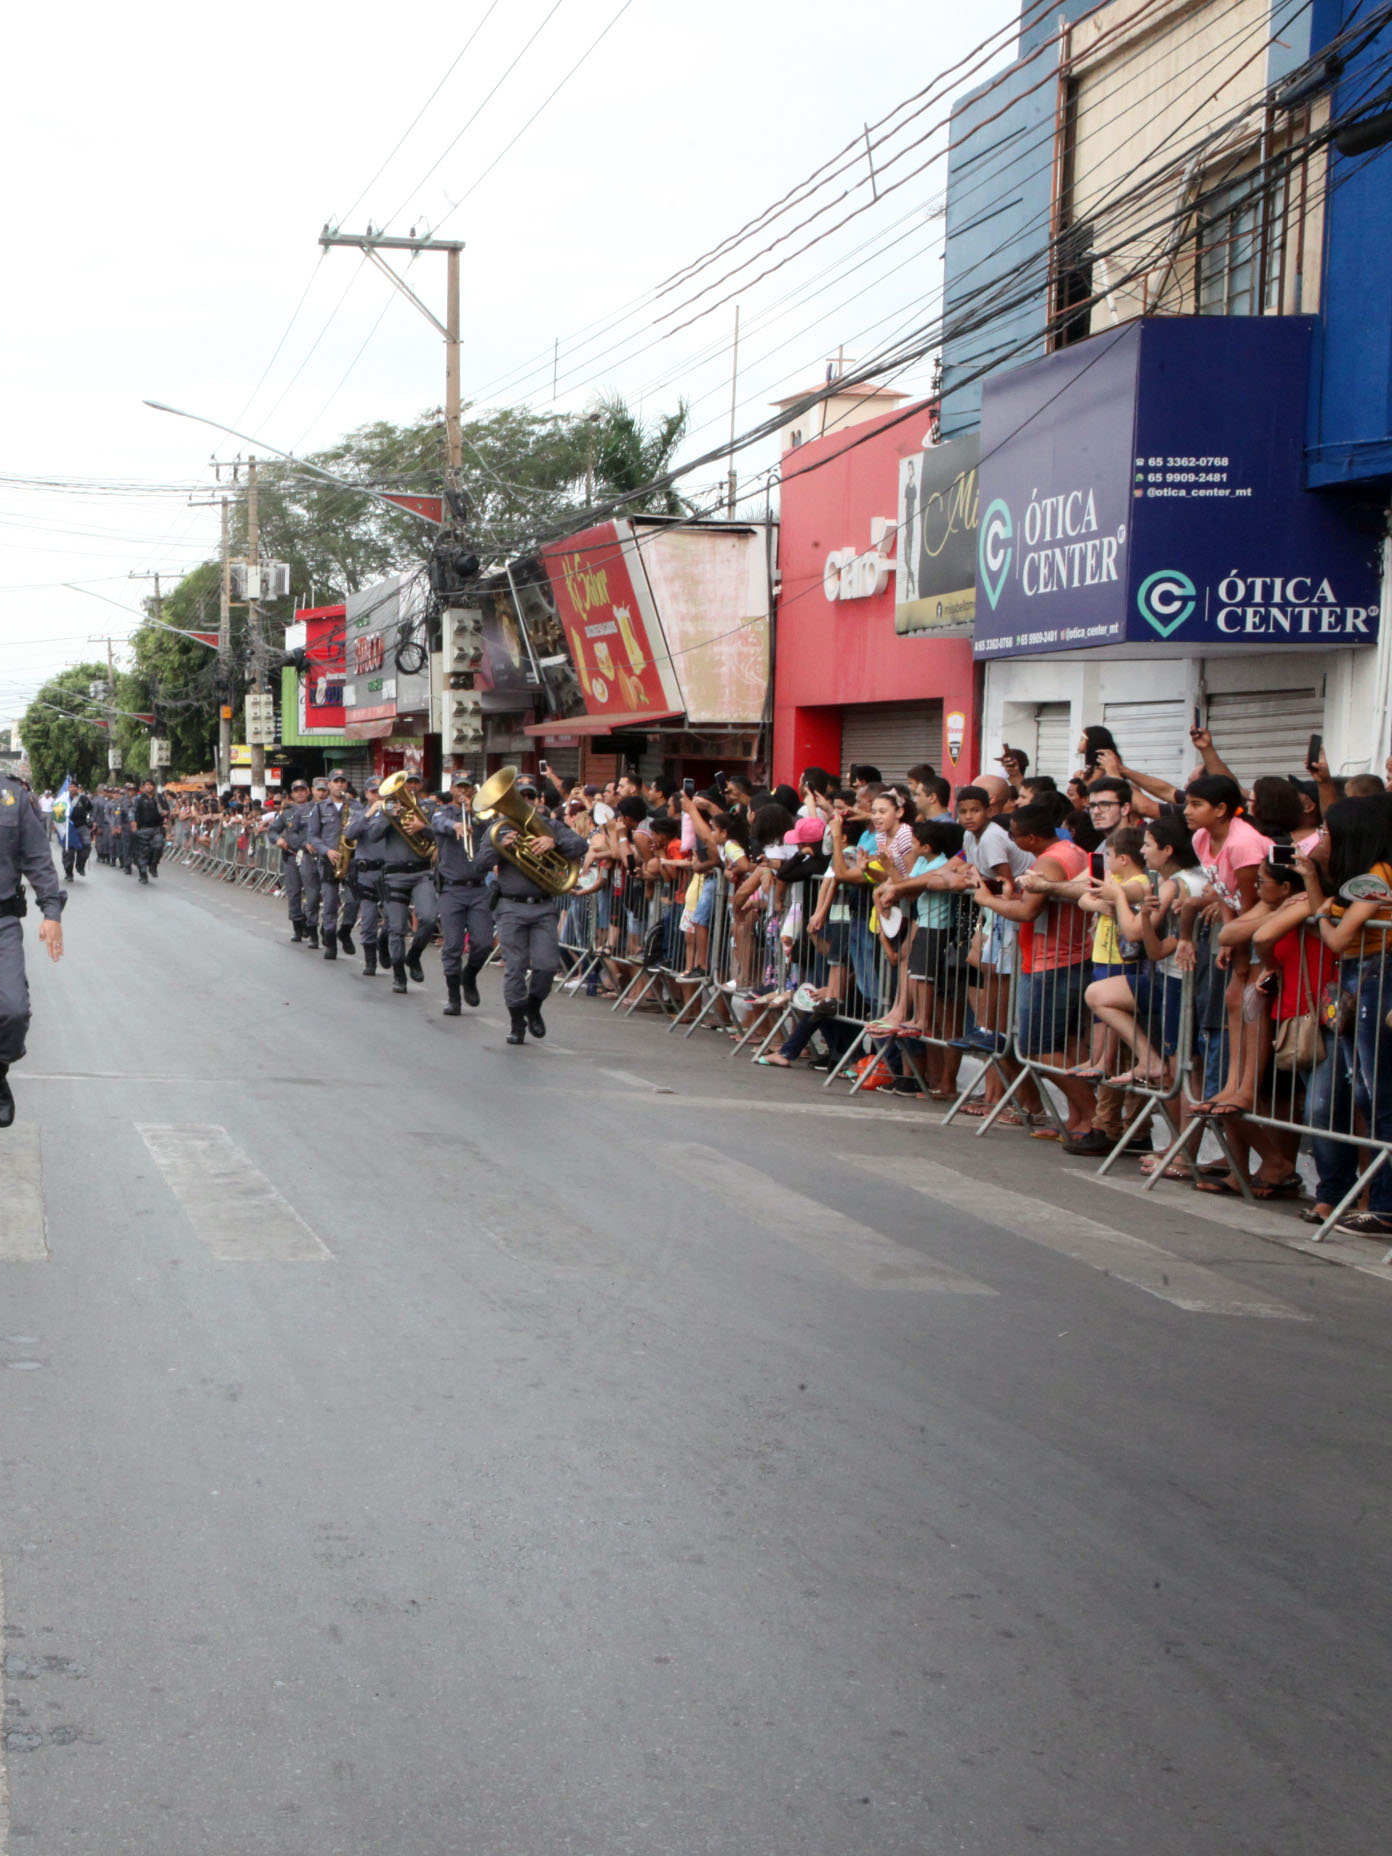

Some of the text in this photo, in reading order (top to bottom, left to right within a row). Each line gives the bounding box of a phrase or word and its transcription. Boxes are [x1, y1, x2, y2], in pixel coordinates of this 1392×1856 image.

[1148, 457, 1229, 467] 65 3362-0768
[1148, 473, 1228, 482] 65 9909-2481
[1147, 487, 1252, 498] @otica_center_mt
[1024, 487, 1099, 546] ÓTICA
[824, 546, 889, 603] Claro
[1022, 536, 1119, 597] CENTER
[1217, 568, 1338, 604] ÓTICA
[1216, 605, 1370, 633] CENTER
[1020, 636, 1028, 646] 65
[1029, 630, 1058, 645] 9909-2481
